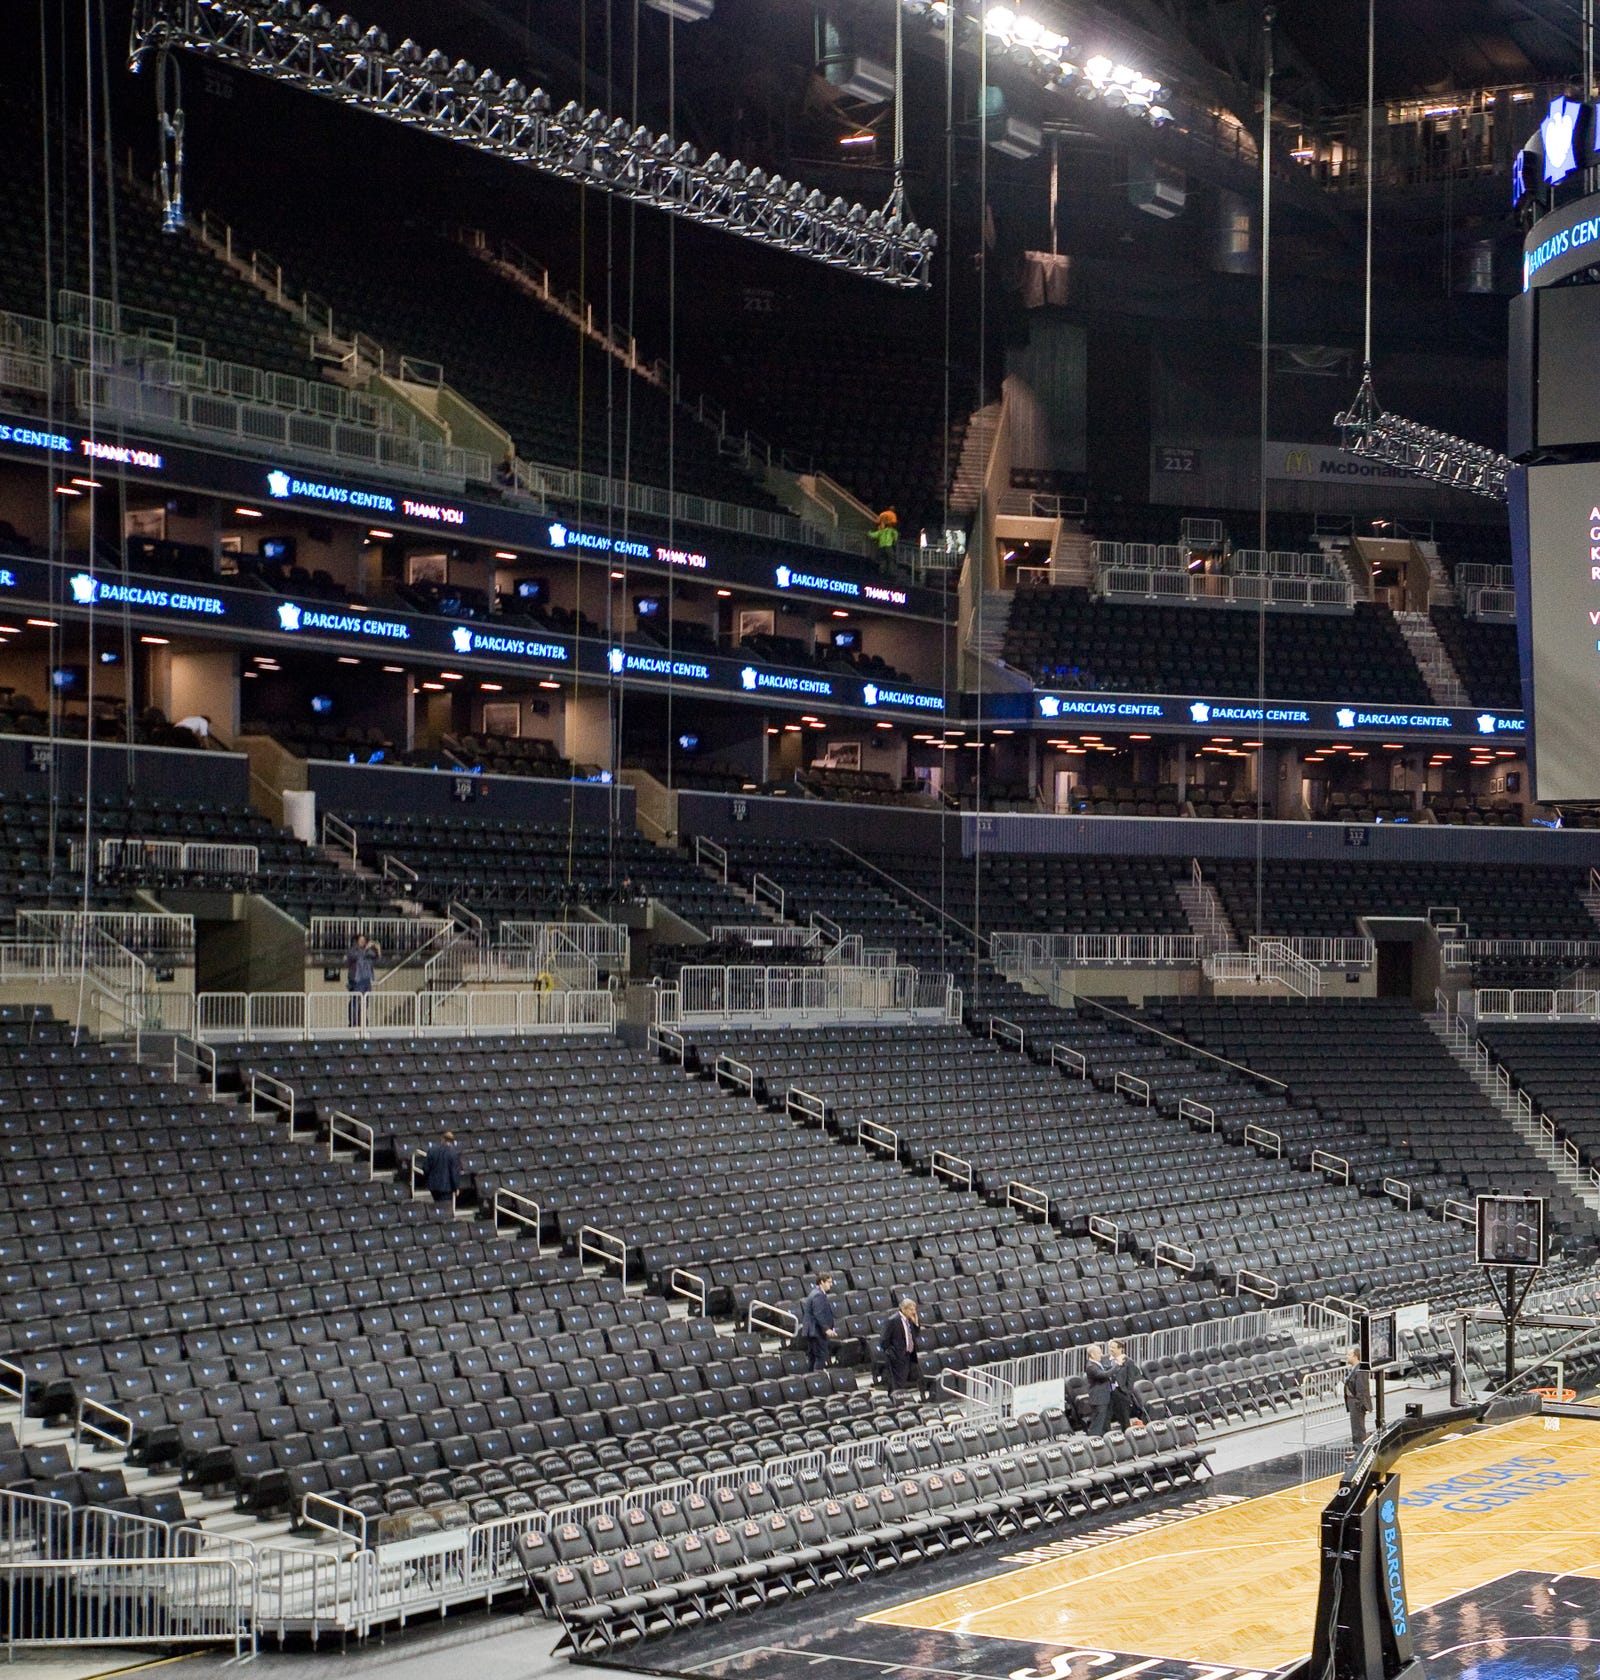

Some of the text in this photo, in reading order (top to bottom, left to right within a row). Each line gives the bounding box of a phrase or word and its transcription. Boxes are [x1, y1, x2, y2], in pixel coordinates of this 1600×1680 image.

[80, 439, 129, 463] THANK
[130, 450, 162, 468] YOU
[1164, 457, 1193, 472] 212
[291, 479, 348, 502] BARCLAYS
[402, 500, 440, 520] THANK
[441, 507, 463, 524] YOU
[687, 553, 706, 569] YOU
[99, 583, 168, 607] BARCLAYS
[303, 611, 361, 633] BARCLAYS
[474, 634, 525, 654] BARCLAYS
[626, 656, 671, 674] BARCLAYS
[1062, 701, 1117, 716] BARCLAYS
[1358, 713, 1406, 726] BARCLAYS
[1442, 1470, 1591, 1514] CENTER
[1384, 1527, 1407, 1637] BARCLAYS
